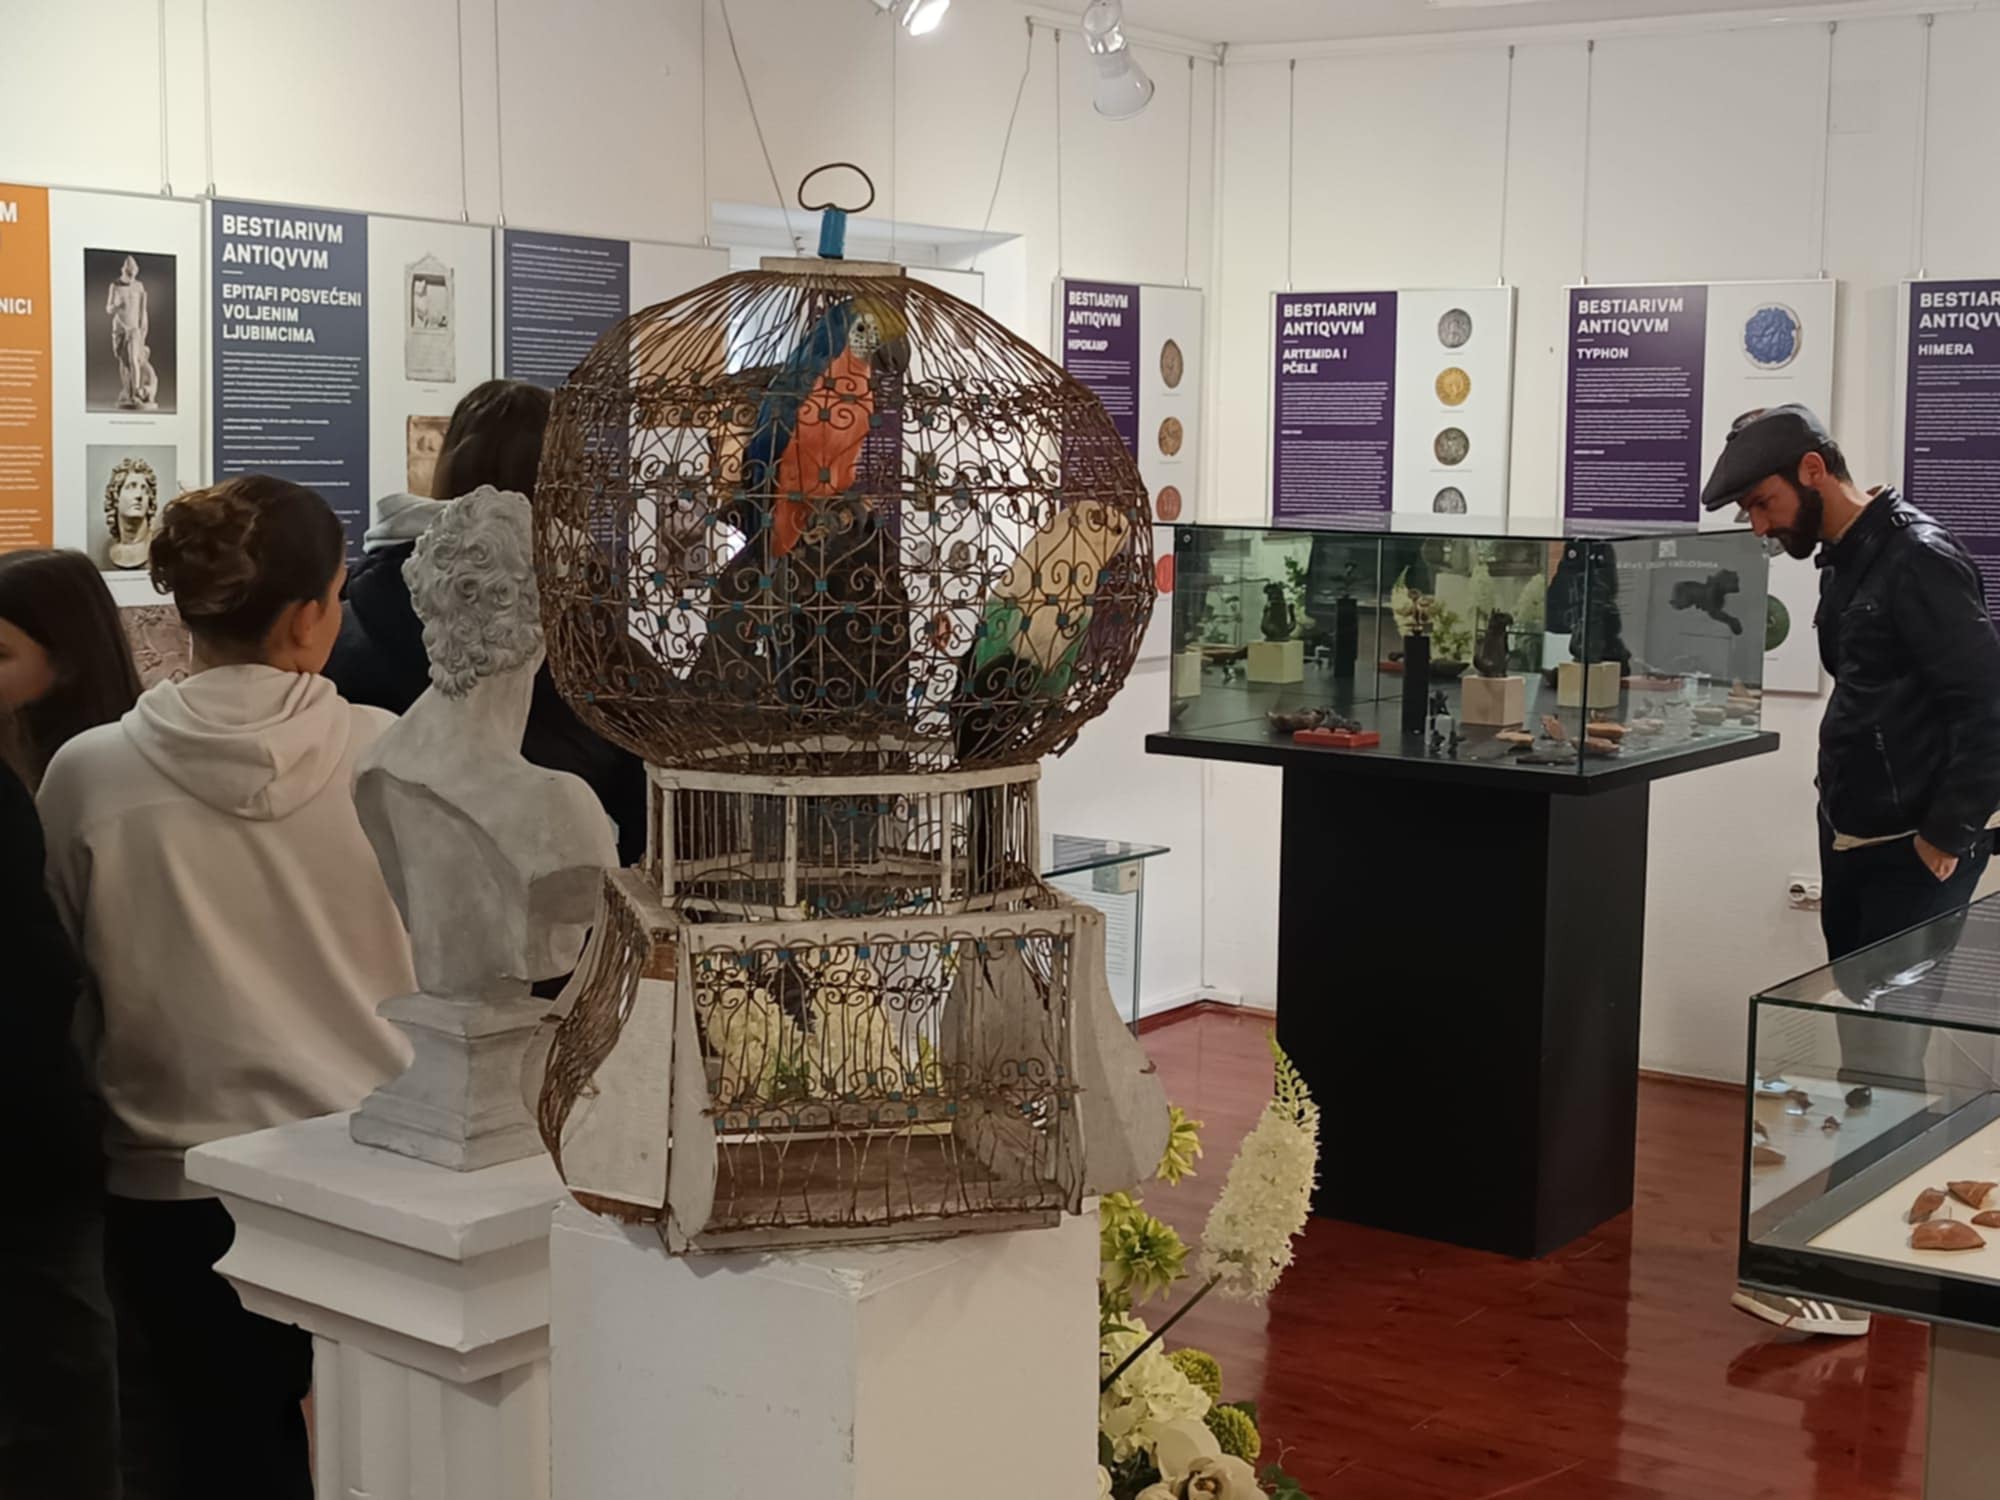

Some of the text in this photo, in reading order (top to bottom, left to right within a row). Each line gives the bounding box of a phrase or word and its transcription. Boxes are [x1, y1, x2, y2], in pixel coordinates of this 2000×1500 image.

[222, 214, 344, 244] BESTIARIVM
[222, 242, 329, 270] ANTIQVVM
[222, 283, 362, 307] EPITAFI POSVEĆENI
[1068, 290, 1129, 309] BESTIARIVM
[222, 303, 299, 323] VOLJENIM
[1283, 302, 1377, 318] BESTIARIVM
[1578, 297, 1684, 315] BESTIARIVM
[1068, 310, 1122, 329] ANTIQVVM
[1577, 318, 1669, 336] ANTIQVVM
[222, 323, 316, 344] LJUBIMCIMA
[1283, 320, 1365, 338] ANTIQVVM
[1282, 347, 1348, 360] ARTEMIDA I
[1576, 347, 1629, 360] TYPHON
[1918, 342, 1975, 356] HIMERA
[1282, 361, 1318, 375] PČELE
